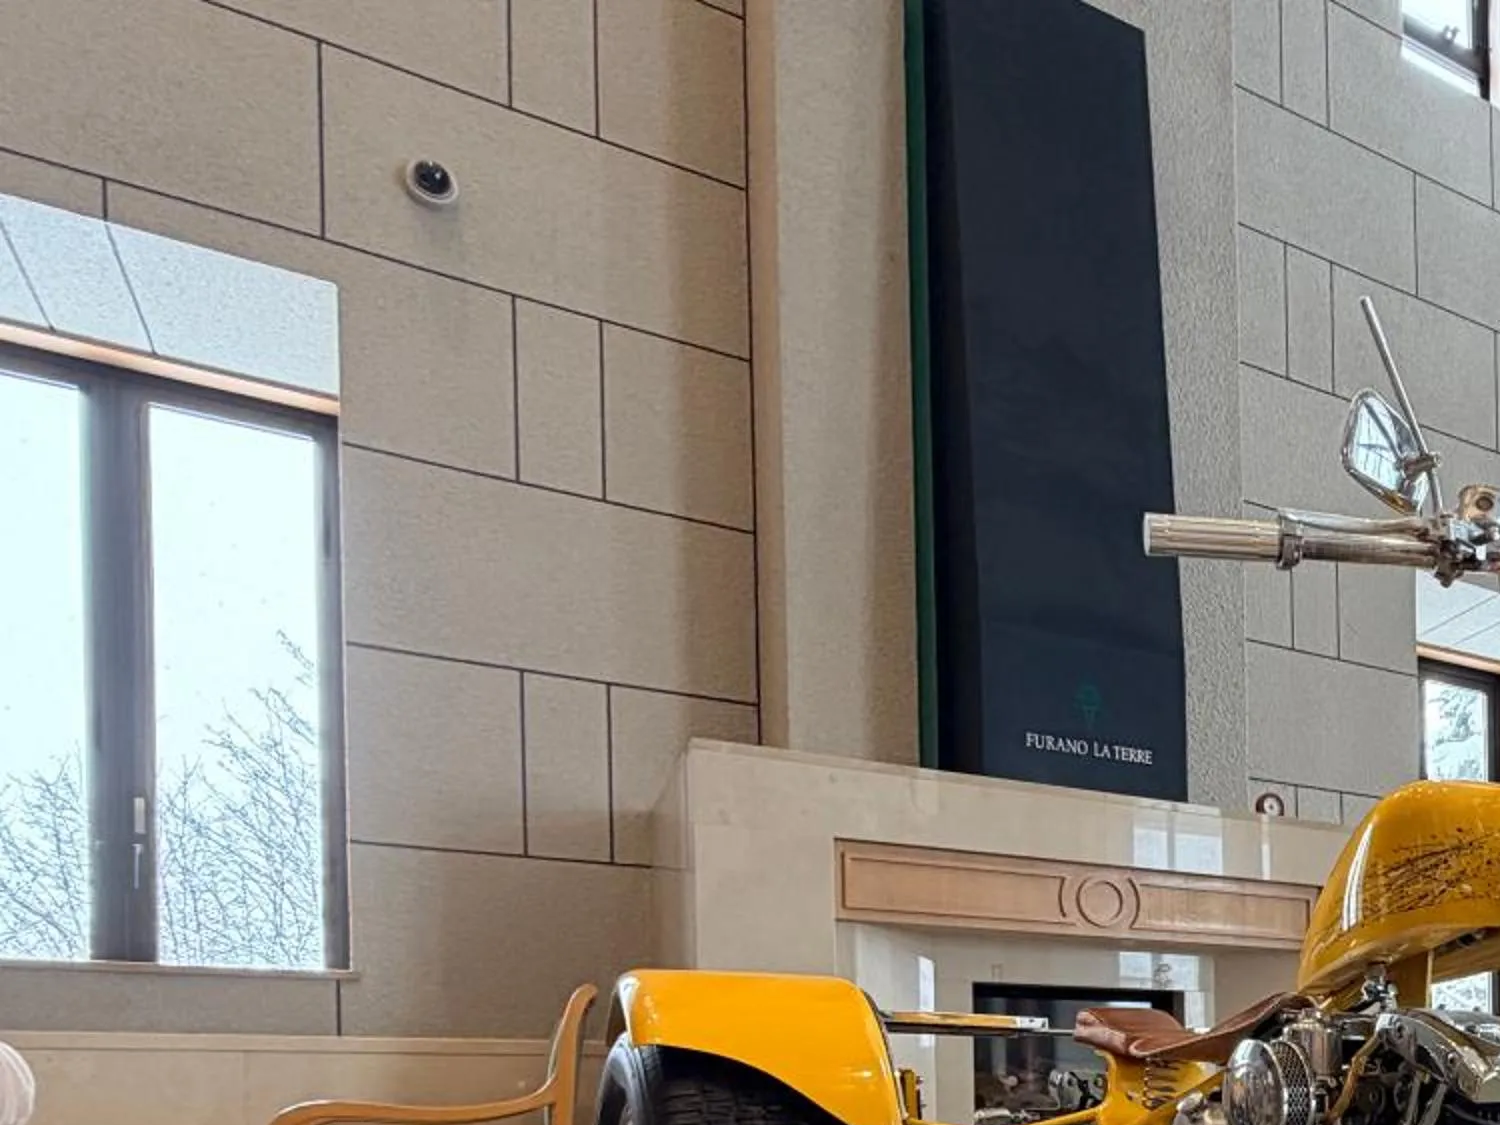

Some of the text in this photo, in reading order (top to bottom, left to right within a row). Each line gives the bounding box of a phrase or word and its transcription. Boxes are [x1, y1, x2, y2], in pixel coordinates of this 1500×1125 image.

[1026, 731, 1152, 765] FURANO LA TERRE
